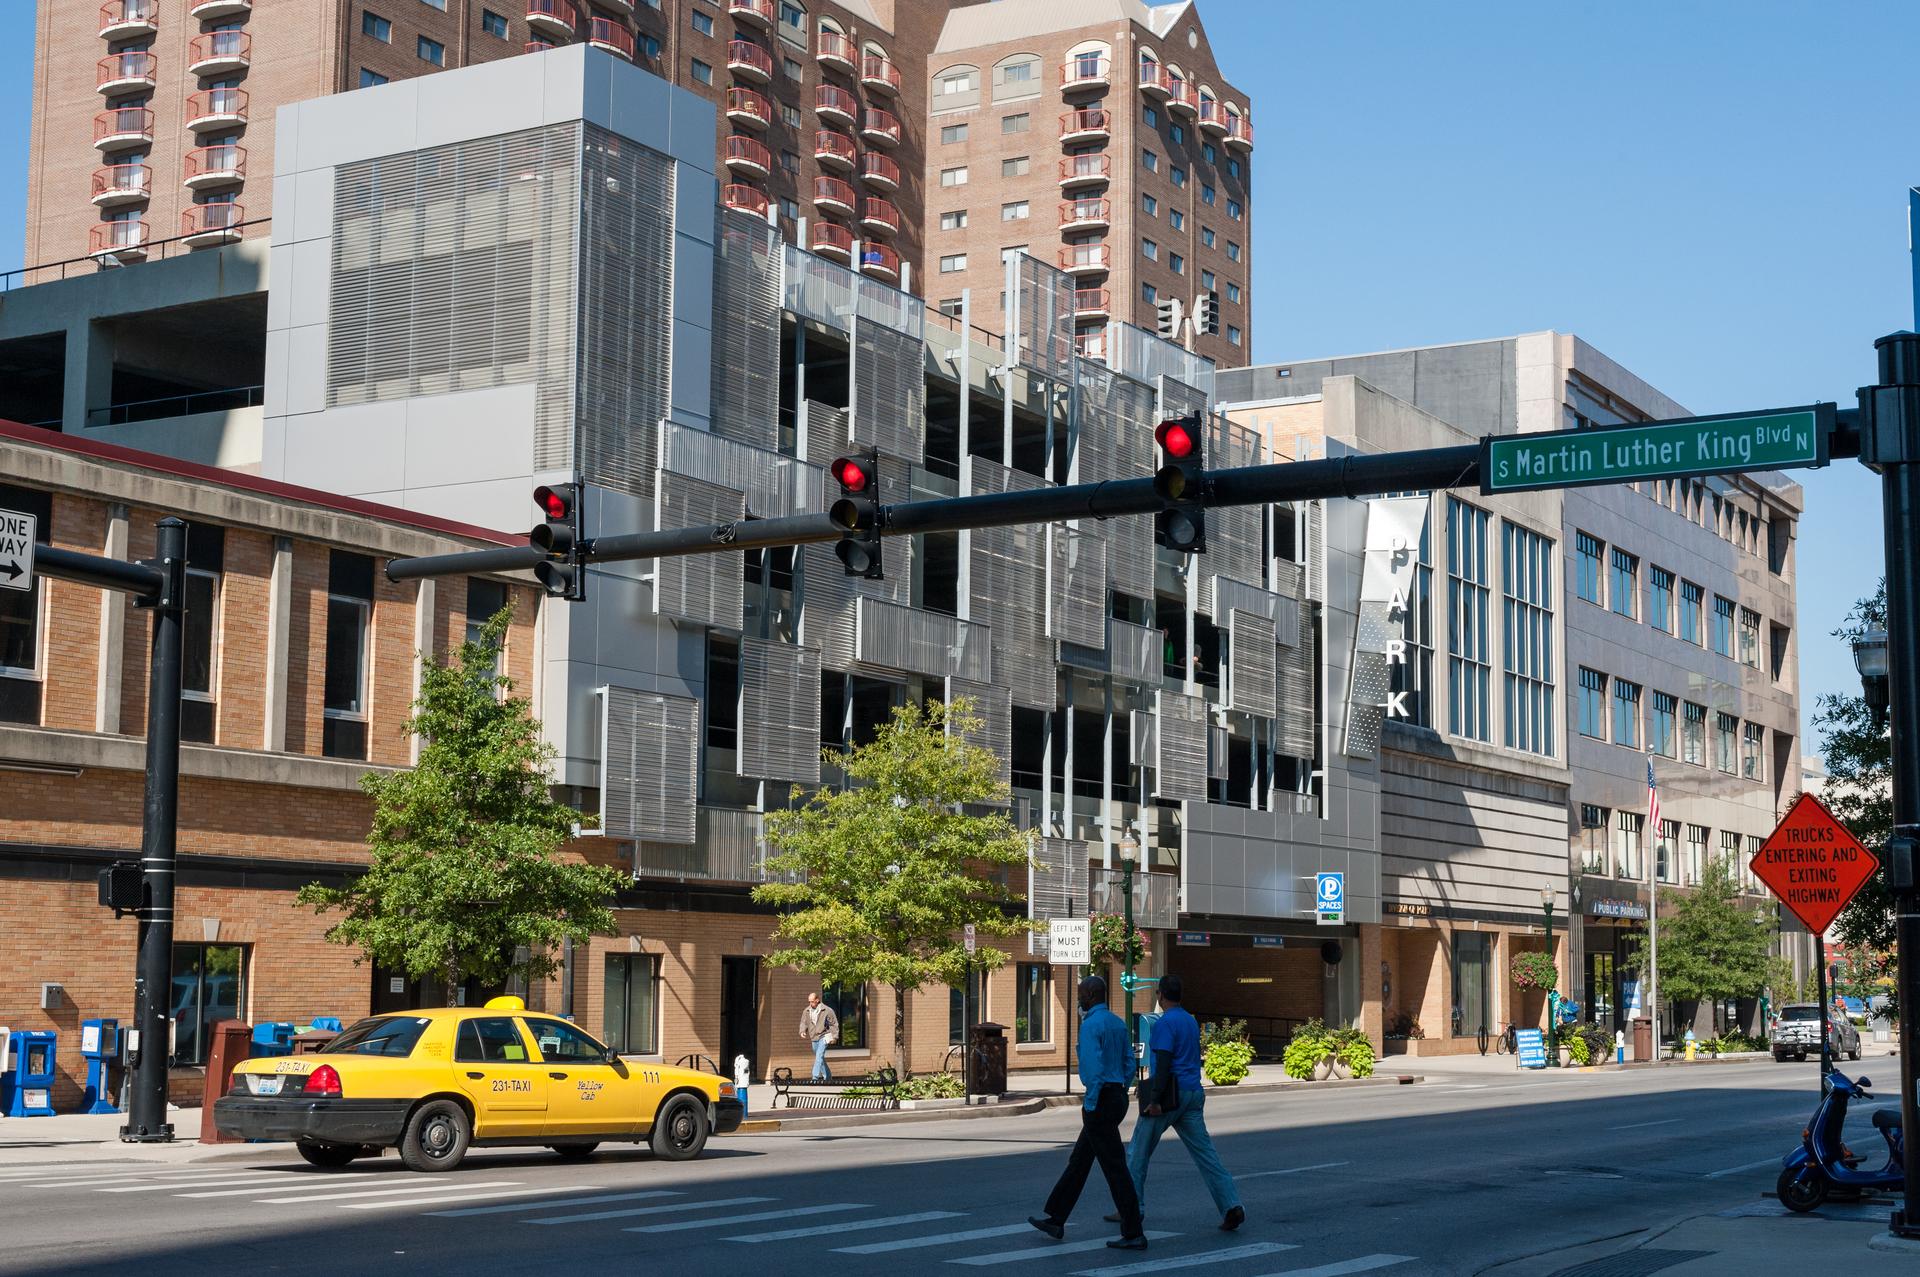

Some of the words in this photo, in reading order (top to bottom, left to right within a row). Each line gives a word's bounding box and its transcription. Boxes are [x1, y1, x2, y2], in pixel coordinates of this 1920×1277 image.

[1498, 460, 1509, 478] S
[1516, 444, 1592, 477] Martin
[1603, 438, 1685, 469] Luther
[1697, 431, 1751, 463] King
[1756, 424, 1791, 445] Blvd
[1796, 433, 1808, 451] N
[1386, 535, 1410, 718] PARK
[1785, 827, 1834, 843] TRUCKS
[1765, 848, 1826, 864] ENTERING
[1832, 847, 1858, 862] AND
[1789, 868, 1837, 883] EXITING
[1788, 888, 1841, 903] HIGHWAY
[1318, 901, 1342, 910] SPACES
[1598, 903, 1619, 915] PUBLIC
[1620, 906, 1644, 917] PARKING
[1058, 937, 1080, 946] MUST
[1053, 950, 1068, 958] TURN
[1071, 950, 1086, 958] LEFT
[275, 1061, 311, 1073] 231-TAXI
[643, 1071, 660, 1084] 111
[492, 1080, 531, 1092] 231-TAXI
[577, 1080, 603, 1090] Yellow
[581, 1091, 596, 1101] Cab
